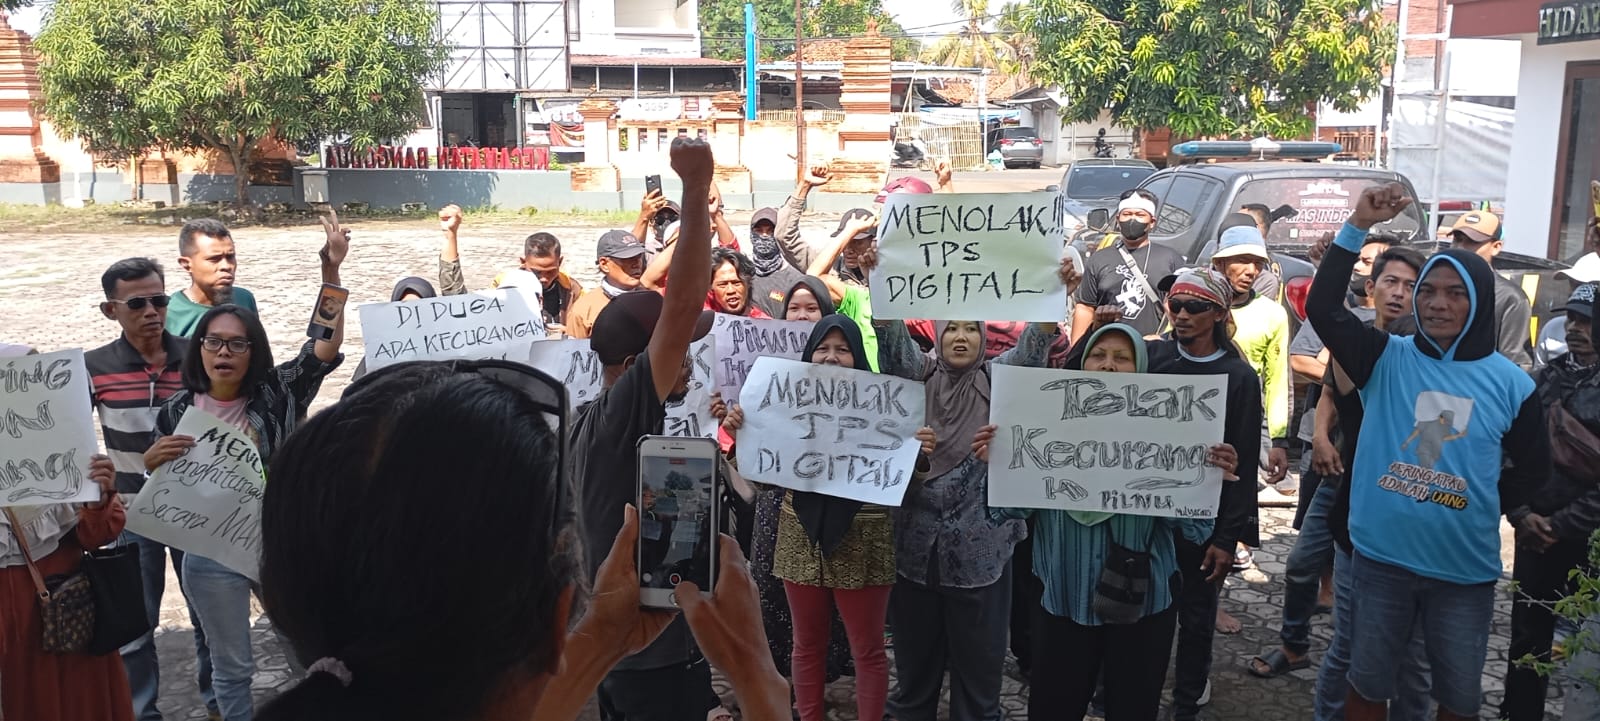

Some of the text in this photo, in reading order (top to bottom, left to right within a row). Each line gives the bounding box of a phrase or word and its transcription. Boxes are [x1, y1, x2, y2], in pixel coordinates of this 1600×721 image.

[919, 241, 980, 267] TPS
[431, 297, 504, 322] DUGA
[374, 319, 543, 359] ADA KECURANGAN
[791, 412, 904, 451] TPS
[1377, 474, 1468, 511] ADALAH UANG
